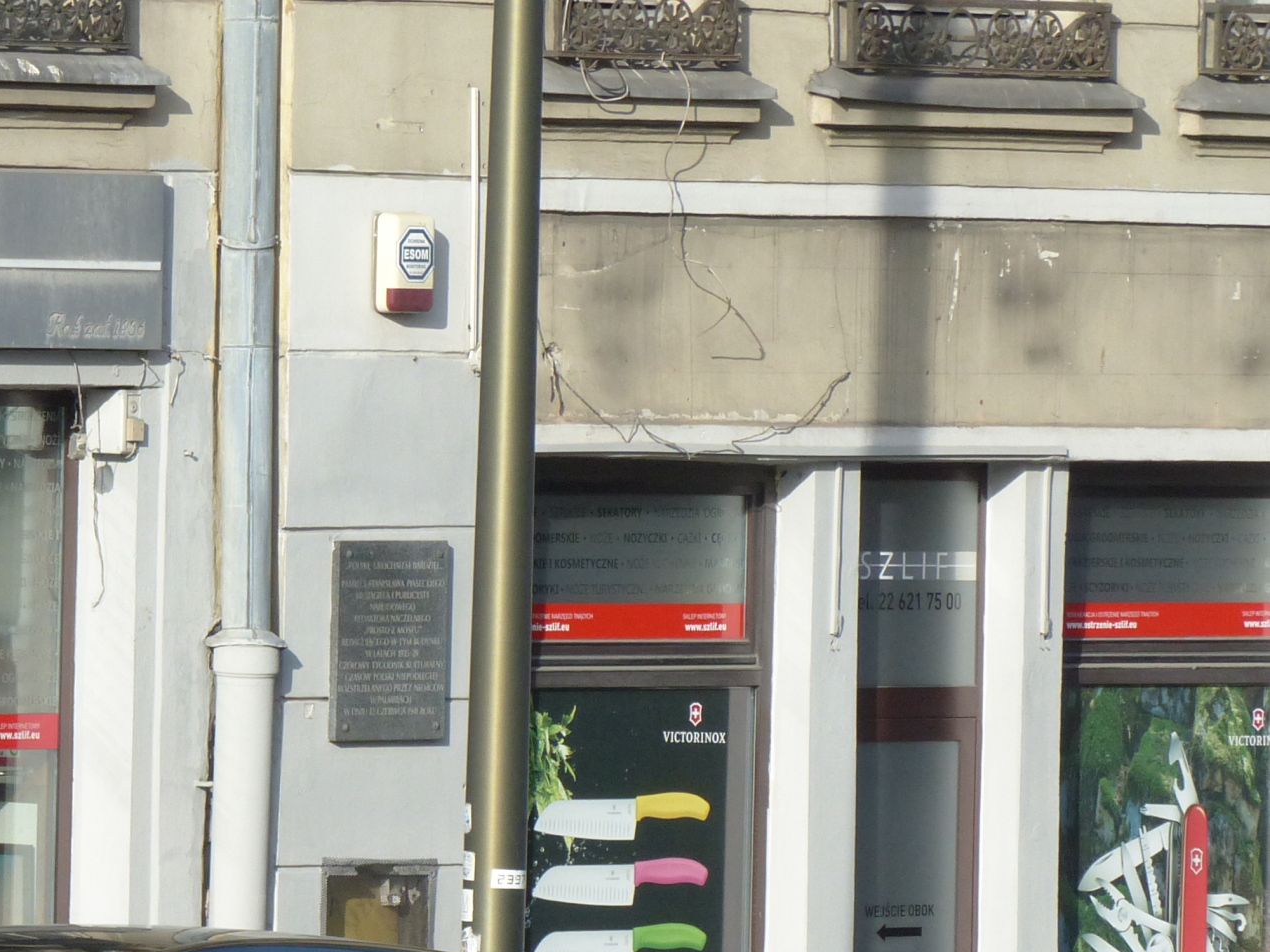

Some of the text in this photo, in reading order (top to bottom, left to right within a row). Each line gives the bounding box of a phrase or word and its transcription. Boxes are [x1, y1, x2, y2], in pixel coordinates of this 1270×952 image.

[404, 248, 428, 260] ESOM
[598, 508, 642, 518] SEKATORY
[554, 559, 619, 570] KOSMETYCZNE
[860, 552, 948, 580] SZLIF
[880, 593, 961, 610] 22 621 75 00
[685, 622, 727, 632] www.szlif.eu
[662, 731, 726, 744] VICTORINOX
[864, 902, 934, 918] WEJŚCIE OBOK
